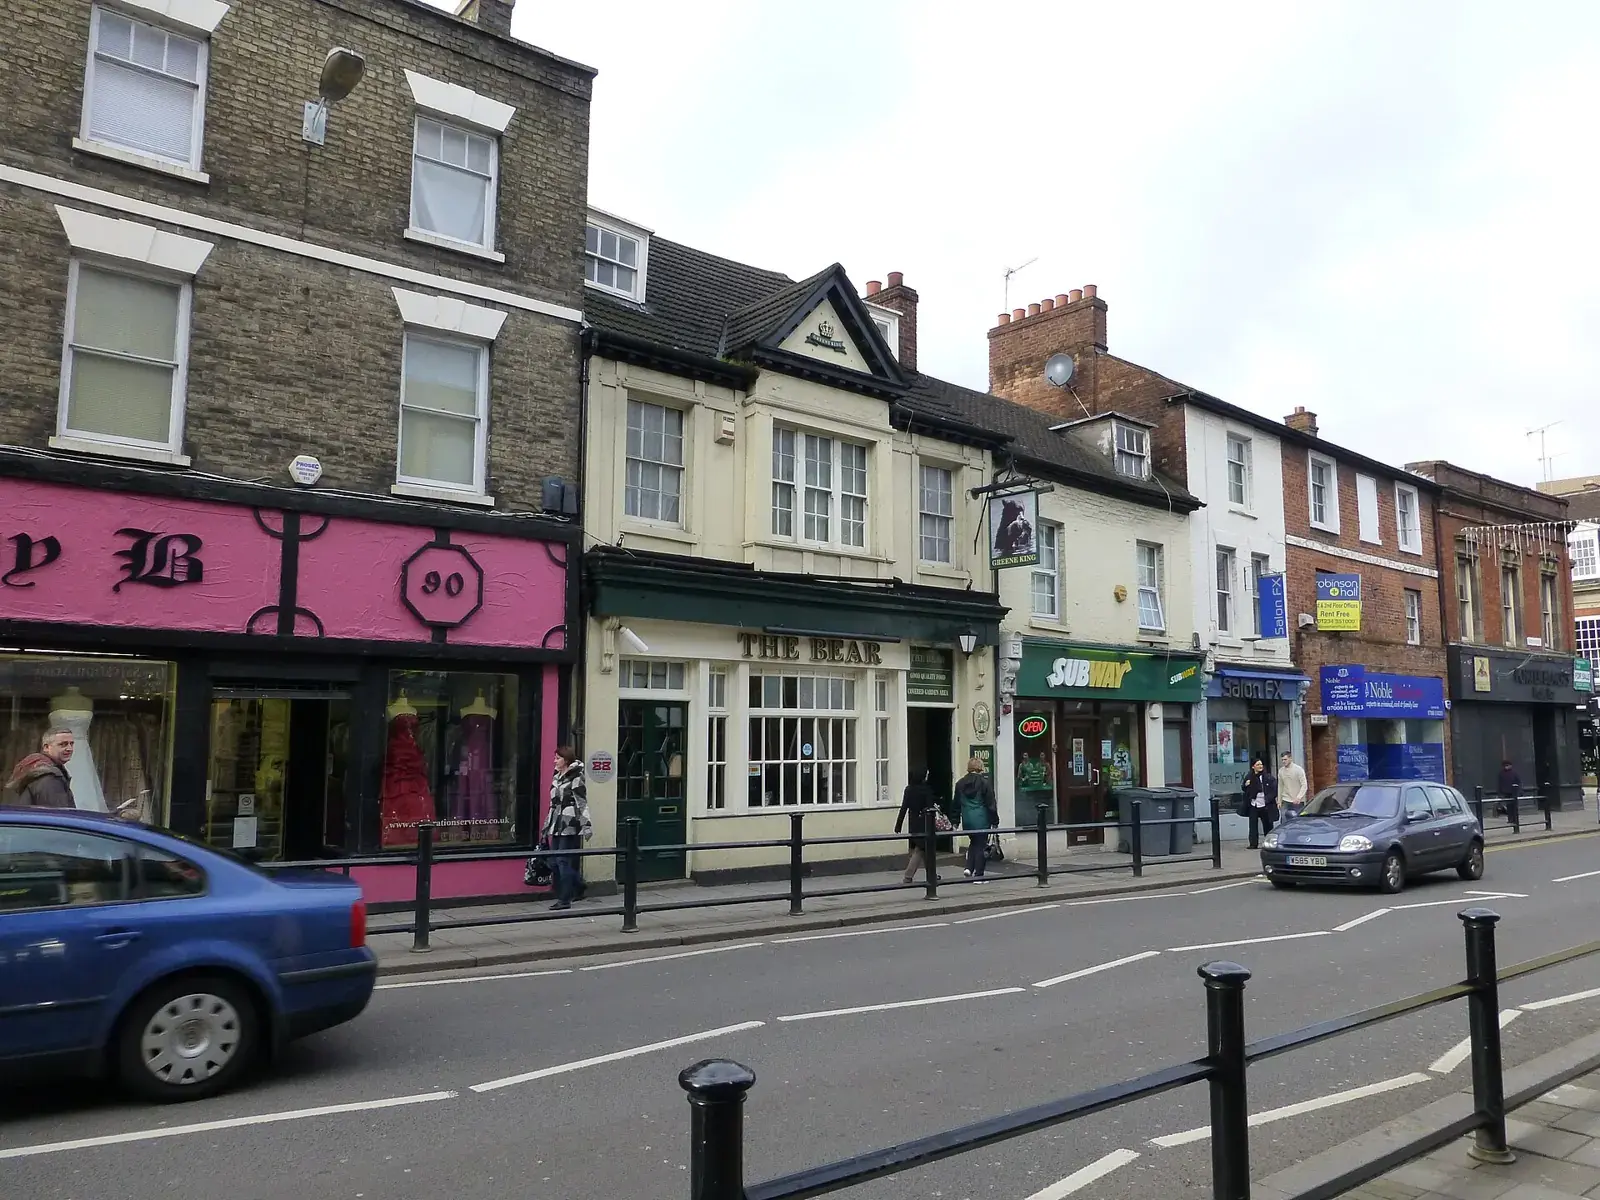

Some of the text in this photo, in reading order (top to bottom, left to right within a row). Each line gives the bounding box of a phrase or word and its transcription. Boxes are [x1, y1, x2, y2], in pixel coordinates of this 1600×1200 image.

[296, 461, 319, 470] PROSEC
[112, 528, 203, 592] B
[991, 554, 1036, 566] GREENE KING
[421, 571, 464, 597] 90
[1340, 587, 1358, 597] hall
[1271, 577, 1285, 635] Salon FX
[738, 632, 883, 665] THE BEAR
[1045, 657, 1132, 689] SUBWAY
[1169, 666, 1197, 684] SUBWAY
[1222, 678, 1283, 700] Salon FX
[1369, 681, 1393, 699] Noble
[1022, 721, 1043, 733] OPEN
[974, 750, 990, 760] FOOD
[389, 816, 510, 829] www.cationservices.co.uk
